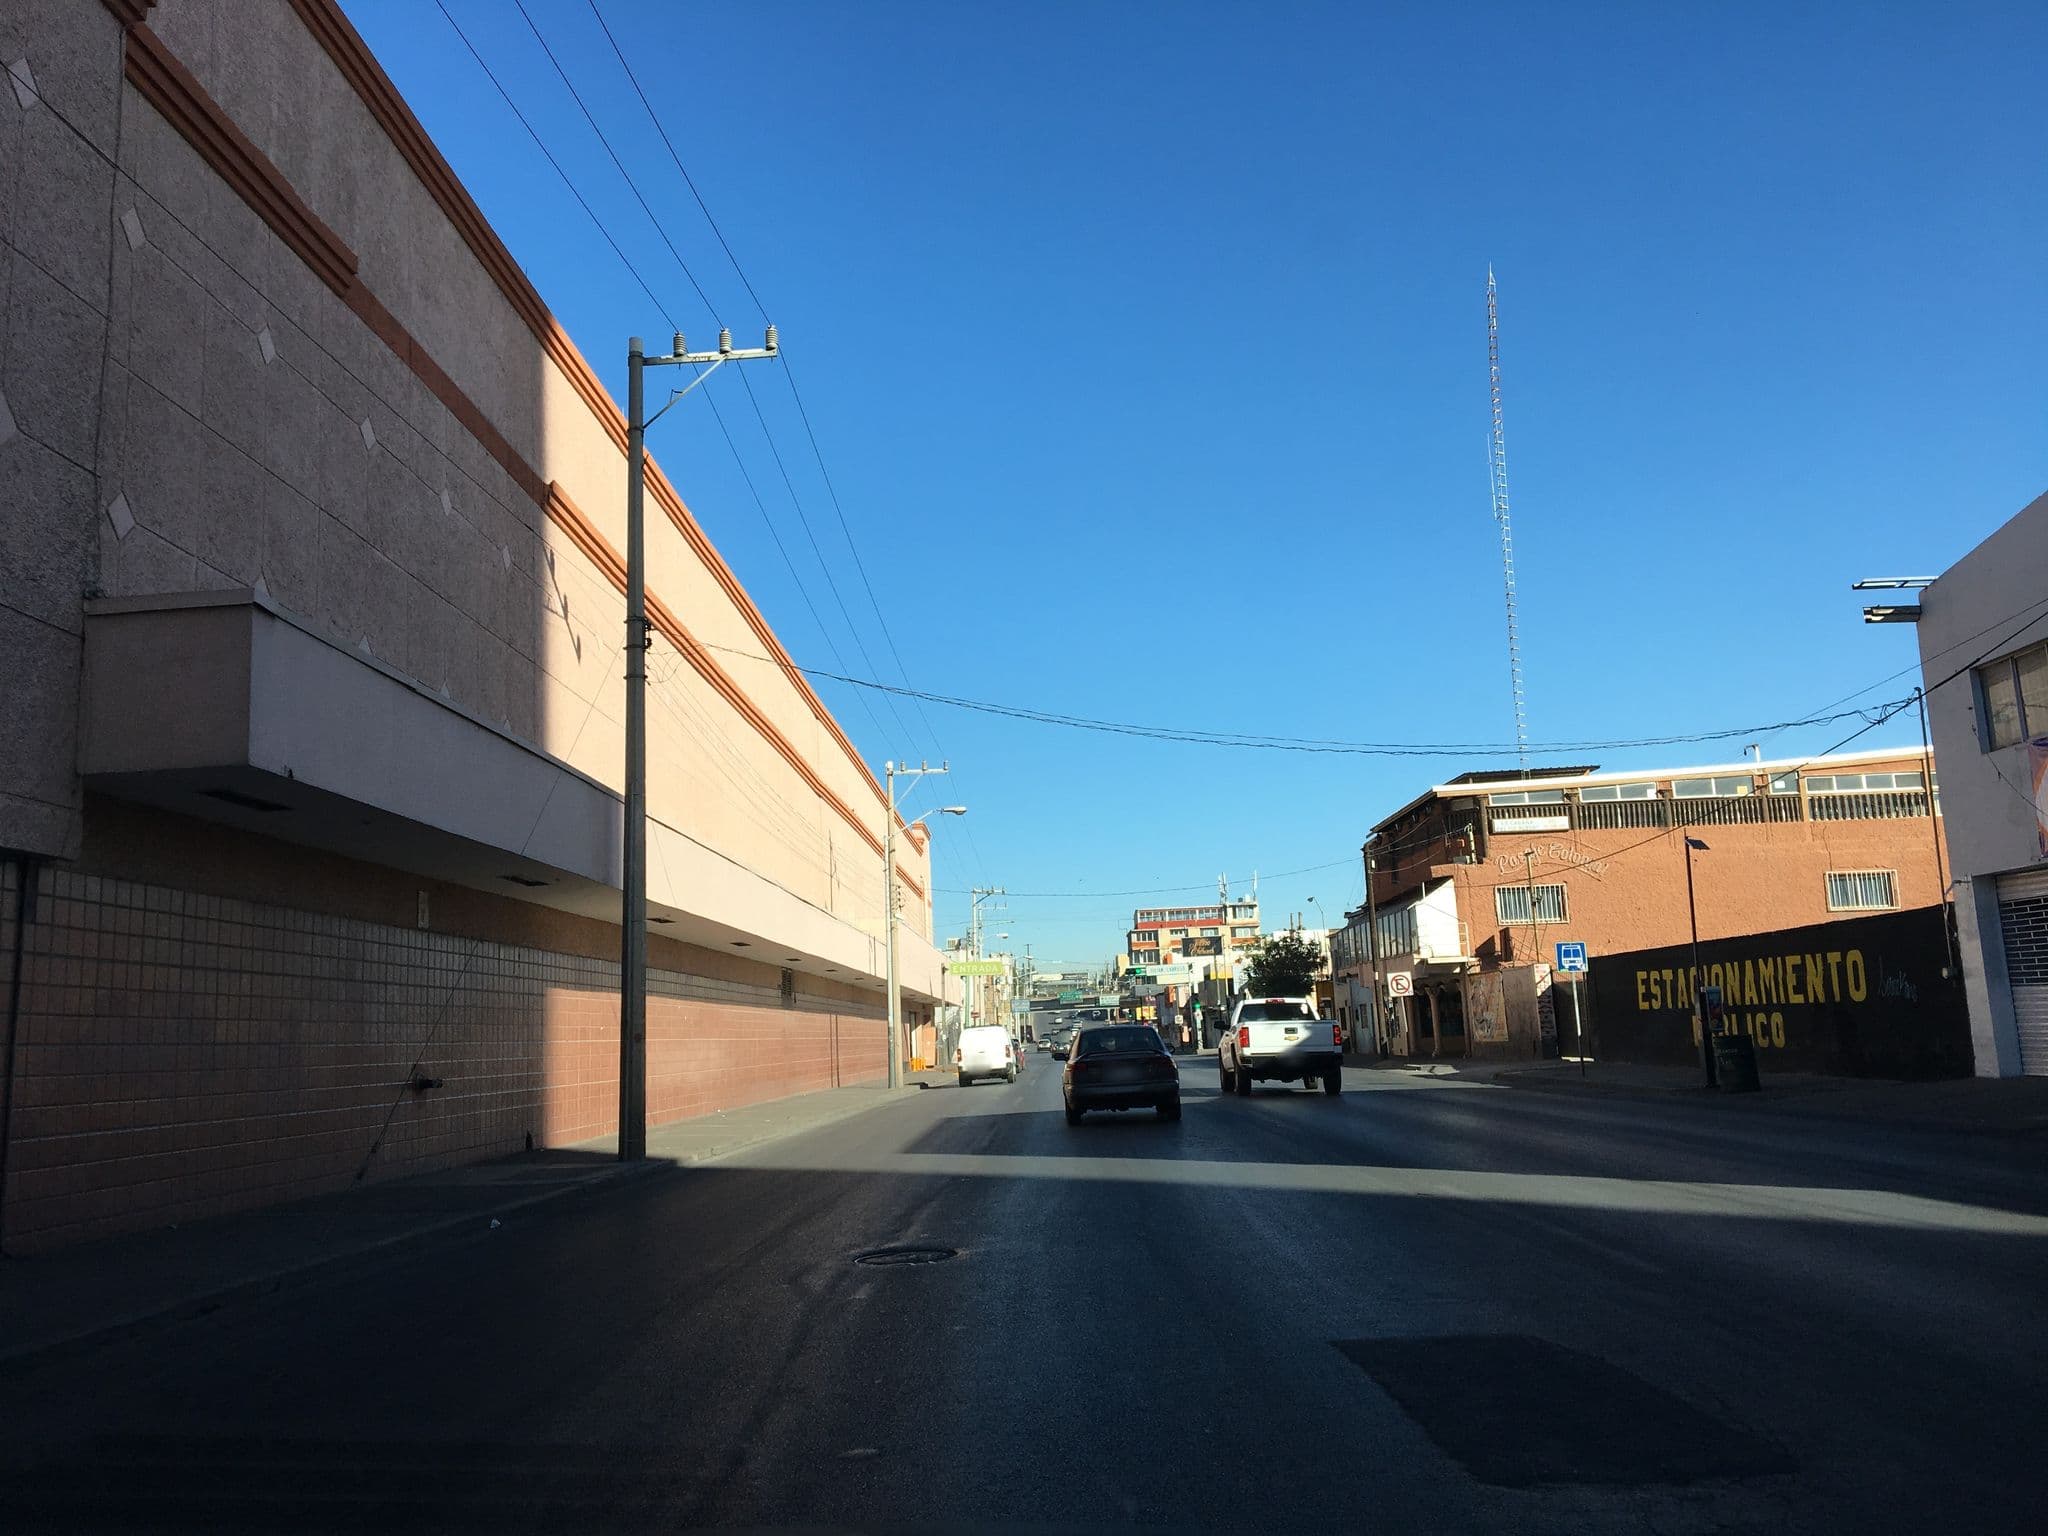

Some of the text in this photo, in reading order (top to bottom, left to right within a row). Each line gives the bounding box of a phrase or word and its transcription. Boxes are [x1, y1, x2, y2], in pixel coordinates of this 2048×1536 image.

[952, 964, 999, 974] ENTRADA
[1636, 949, 1867, 1011] ESTACIONAMIENTO
[1692, 1010, 1786, 1049] PLICO
